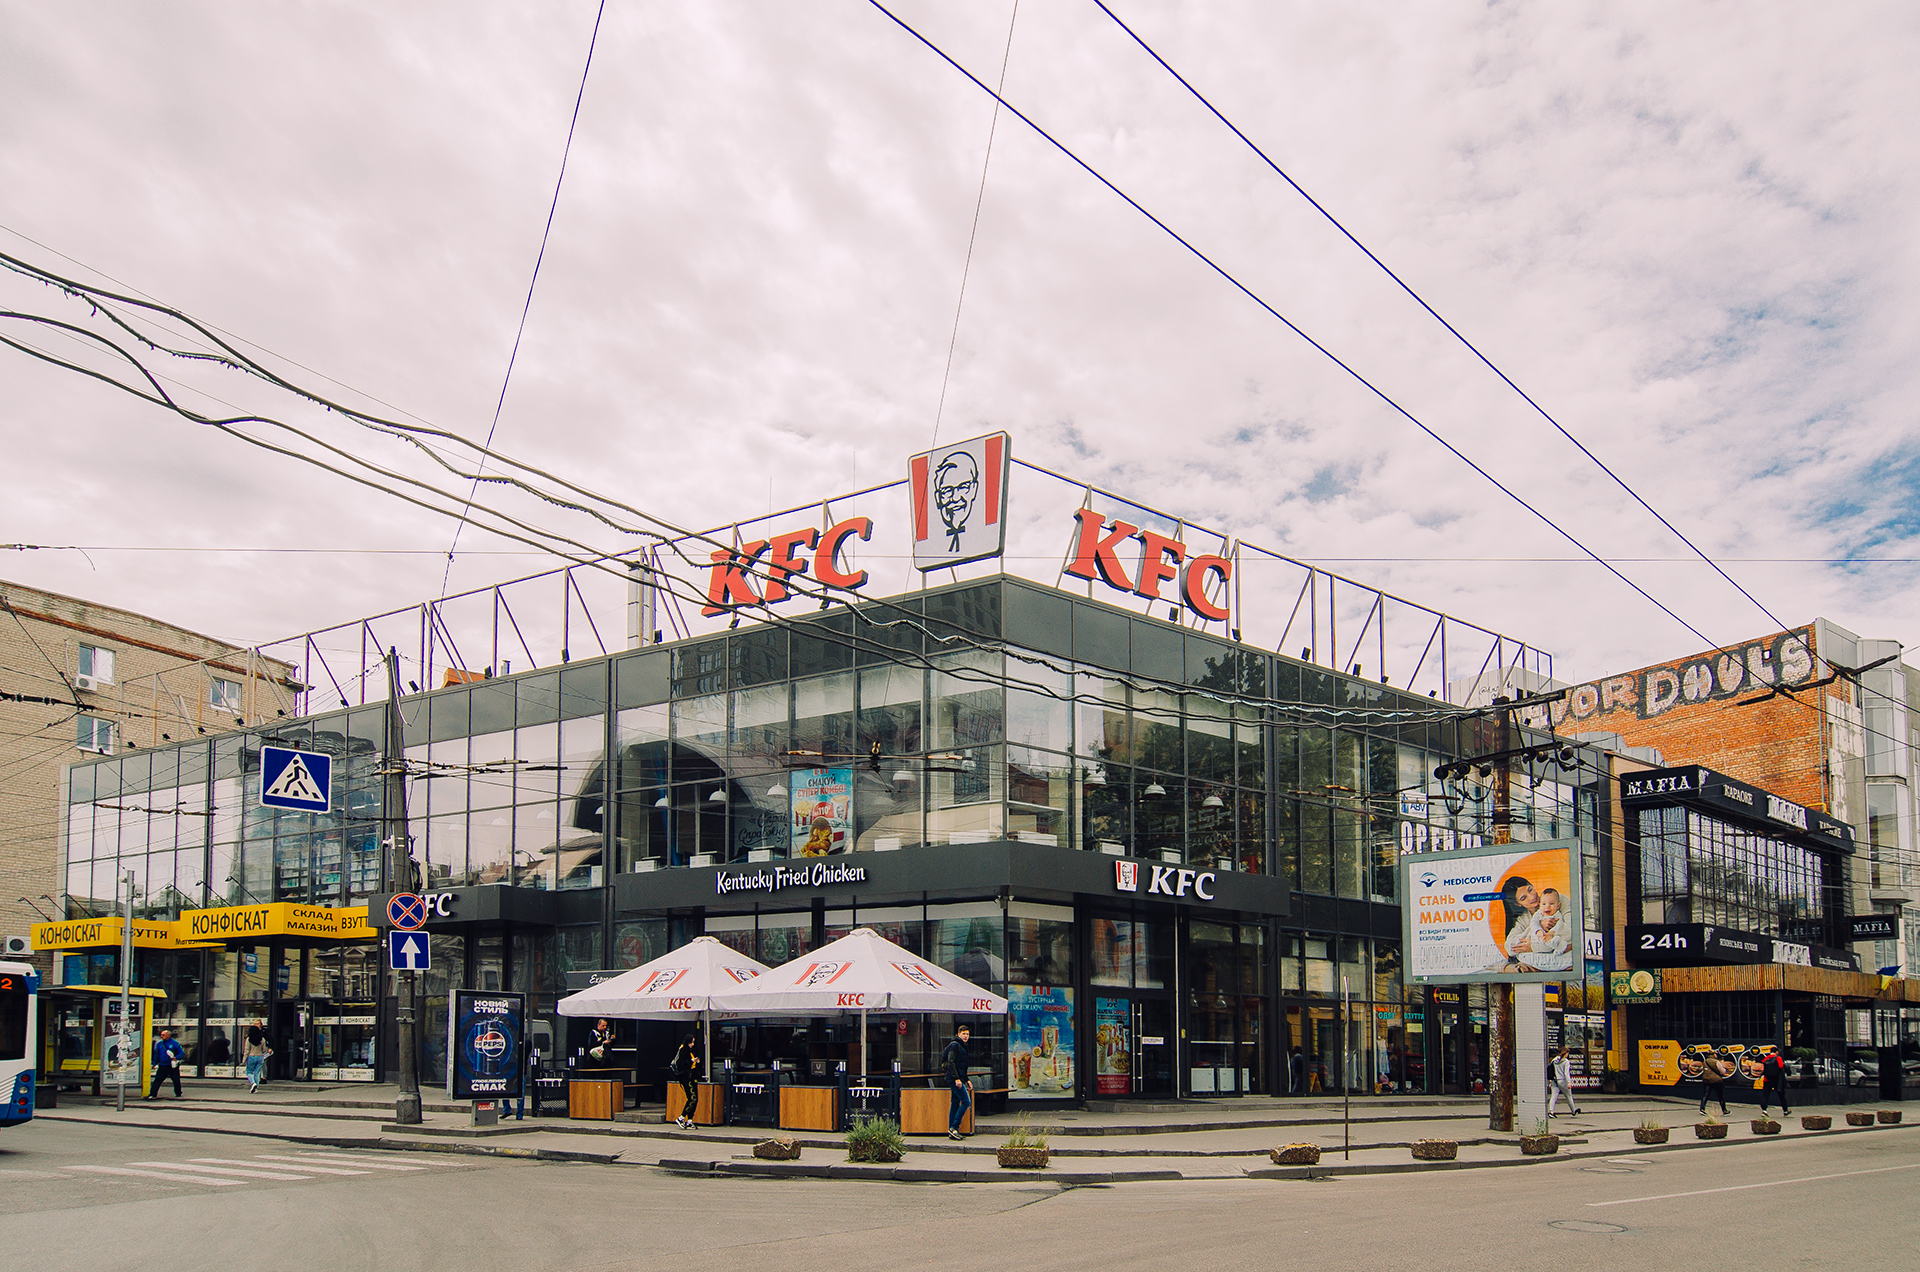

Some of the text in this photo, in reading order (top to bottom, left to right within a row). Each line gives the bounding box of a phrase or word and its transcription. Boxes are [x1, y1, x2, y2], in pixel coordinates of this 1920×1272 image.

[701, 517, 873, 618] KFC
[1063, 508, 1232, 622] KFC
[808, 774, 836, 787] СМАКУЙ
[1626, 775, 1692, 796] MAFIA
[797, 784, 846, 797] СУПЕР КОМБО!
[716, 862, 866, 893] Kentucky Fried Chicken
[1148, 865, 1216, 900] KFC
[1443, 875, 1492, 886] MEDICOVER
[419, 892, 453, 917] FC
[1419, 894, 1456, 906] СТАНЬ
[293, 909, 333, 921] СКЛАД
[1420, 908, 1485, 924] МАМОЮ
[192, 910, 269, 935] КОНФІСКАТ
[287, 921, 338, 932] МАГАЗИН
[1853, 922, 1891, 932] MAFIA
[40, 924, 102, 945] КОНФІСКАТ
[1640, 933, 1687, 949] 24h
[0, 977, 12, 990] 2
[474, 1000, 509, 1008] НОВИЙ
[668, 998, 692, 1010] KFC
[837, 993, 864, 1006] KFC
[972, 998, 992, 1011] KFC
[1404, 1012, 1425, 1020] ВЗУТТЯ
[471, 1083, 507, 1091] СМАК
